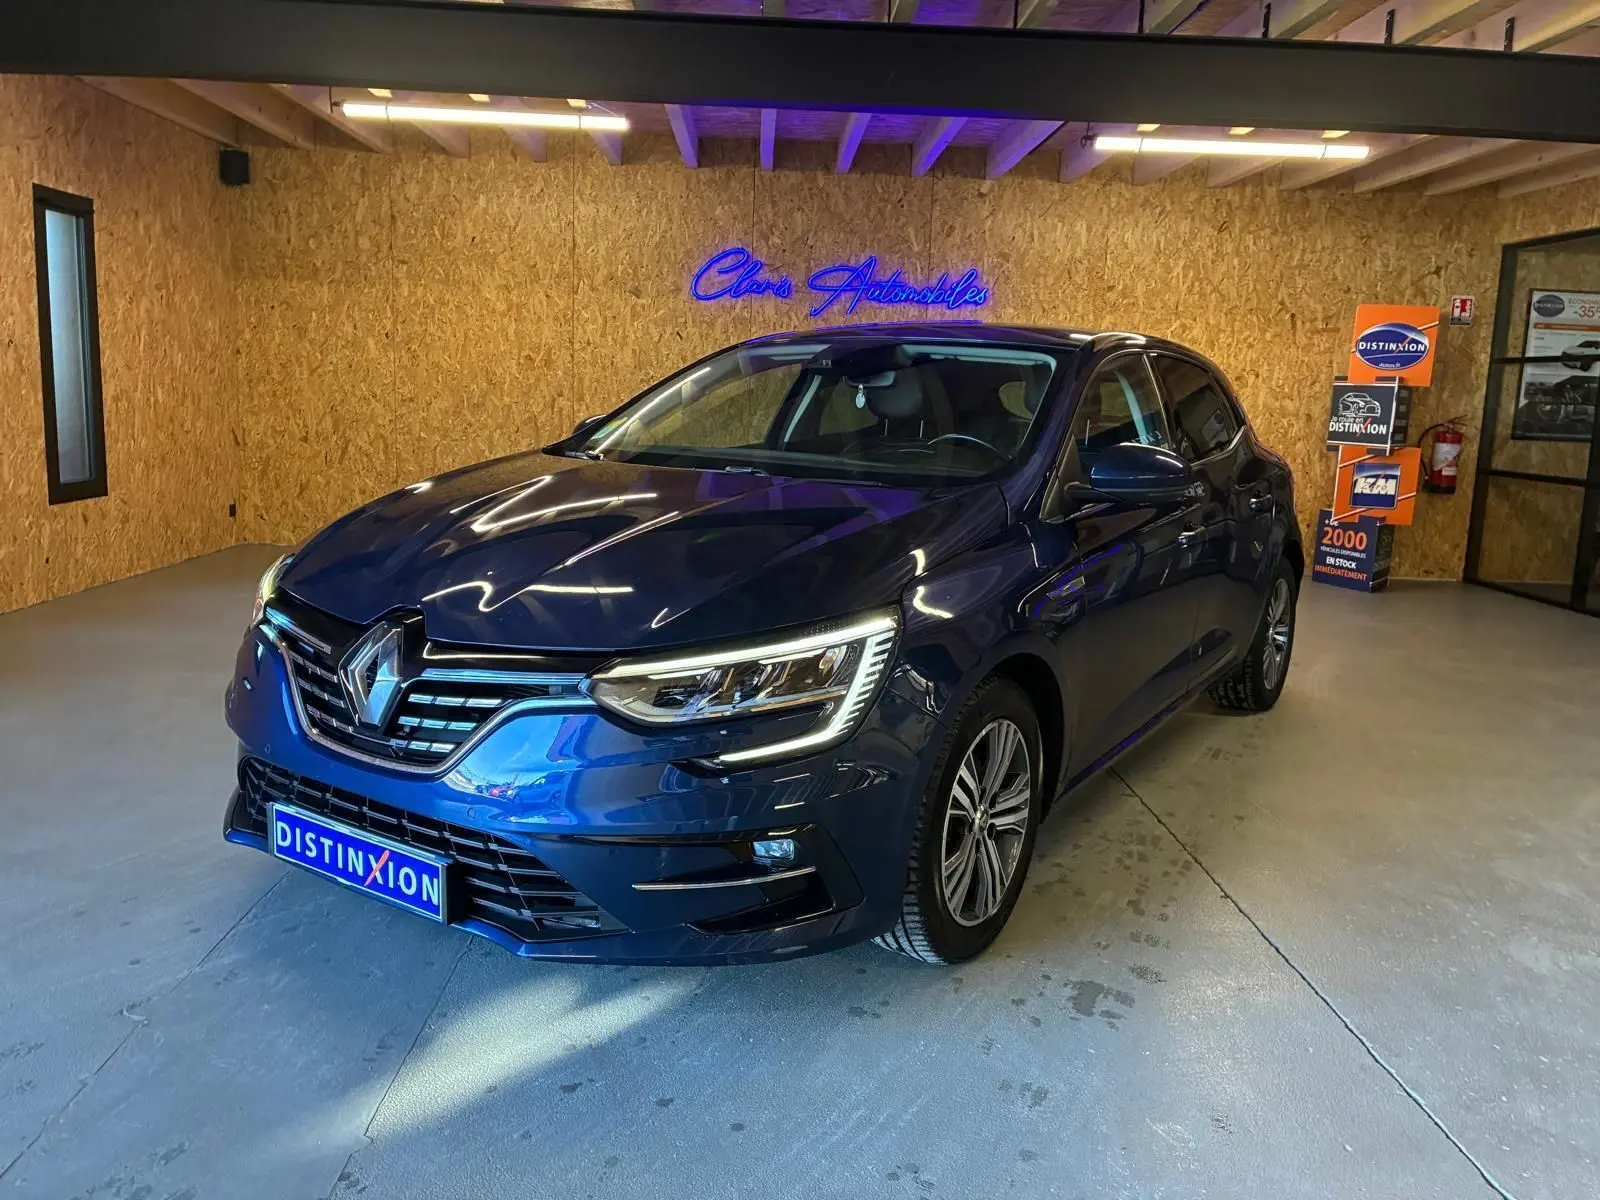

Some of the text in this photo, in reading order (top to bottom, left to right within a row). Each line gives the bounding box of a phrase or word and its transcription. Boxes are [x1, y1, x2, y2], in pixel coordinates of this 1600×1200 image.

[690, 247, 989, 317] Claris Automobiles
[1359, 339, 1426, 352] DISTINXION
[1329, 420, 1387, 436] DISTINXION
[1338, 416, 1354, 424] roule
[1322, 526, 1367, 550] 2000
[1326, 556, 1357, 569] EN STOCK
[1314, 564, 1368, 580] IMMÉDIATEMENT
[276, 820, 439, 906] DISTINXION
